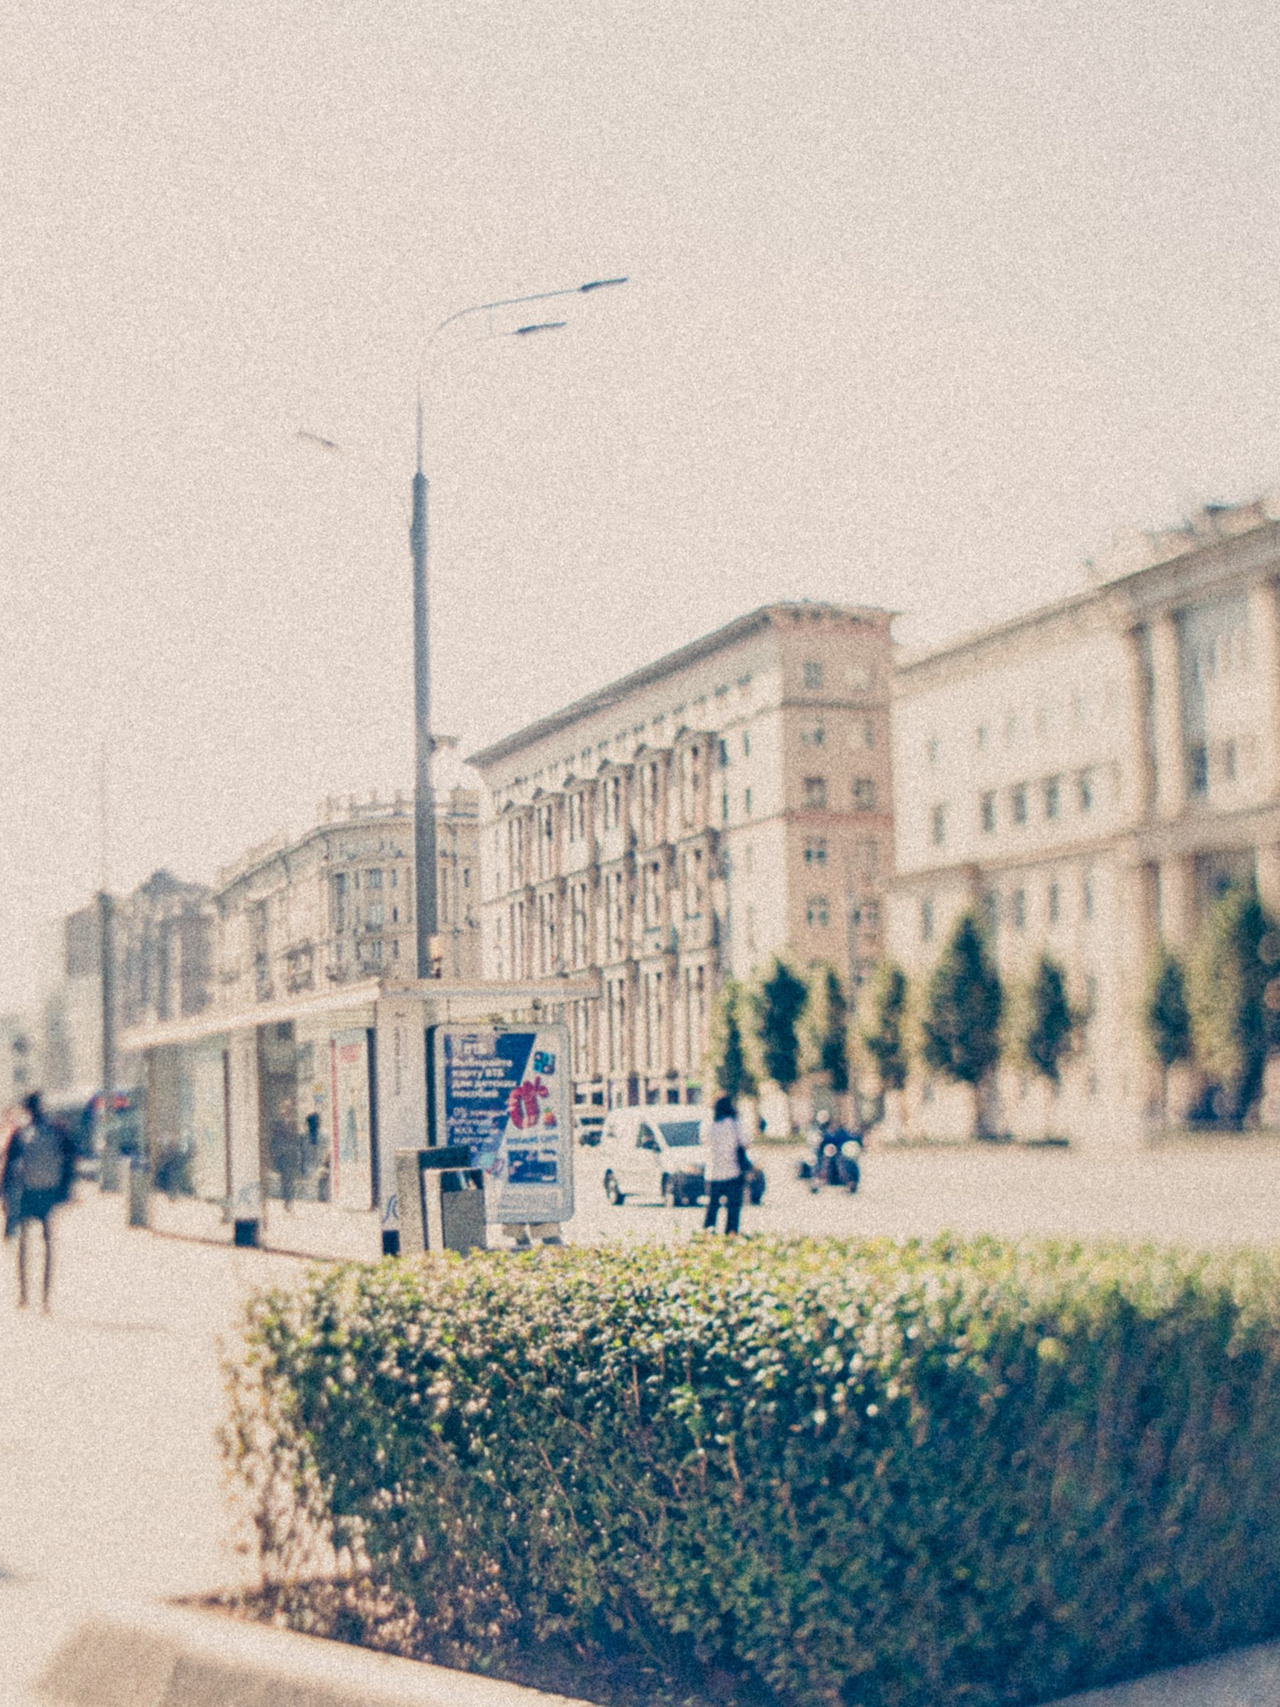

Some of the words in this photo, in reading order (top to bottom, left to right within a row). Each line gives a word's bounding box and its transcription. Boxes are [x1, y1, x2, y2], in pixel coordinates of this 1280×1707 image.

[452, 1070, 483, 1080] карту
[485, 1068, 505, 1077] ВТБ
[452, 1080, 473, 1089] для
